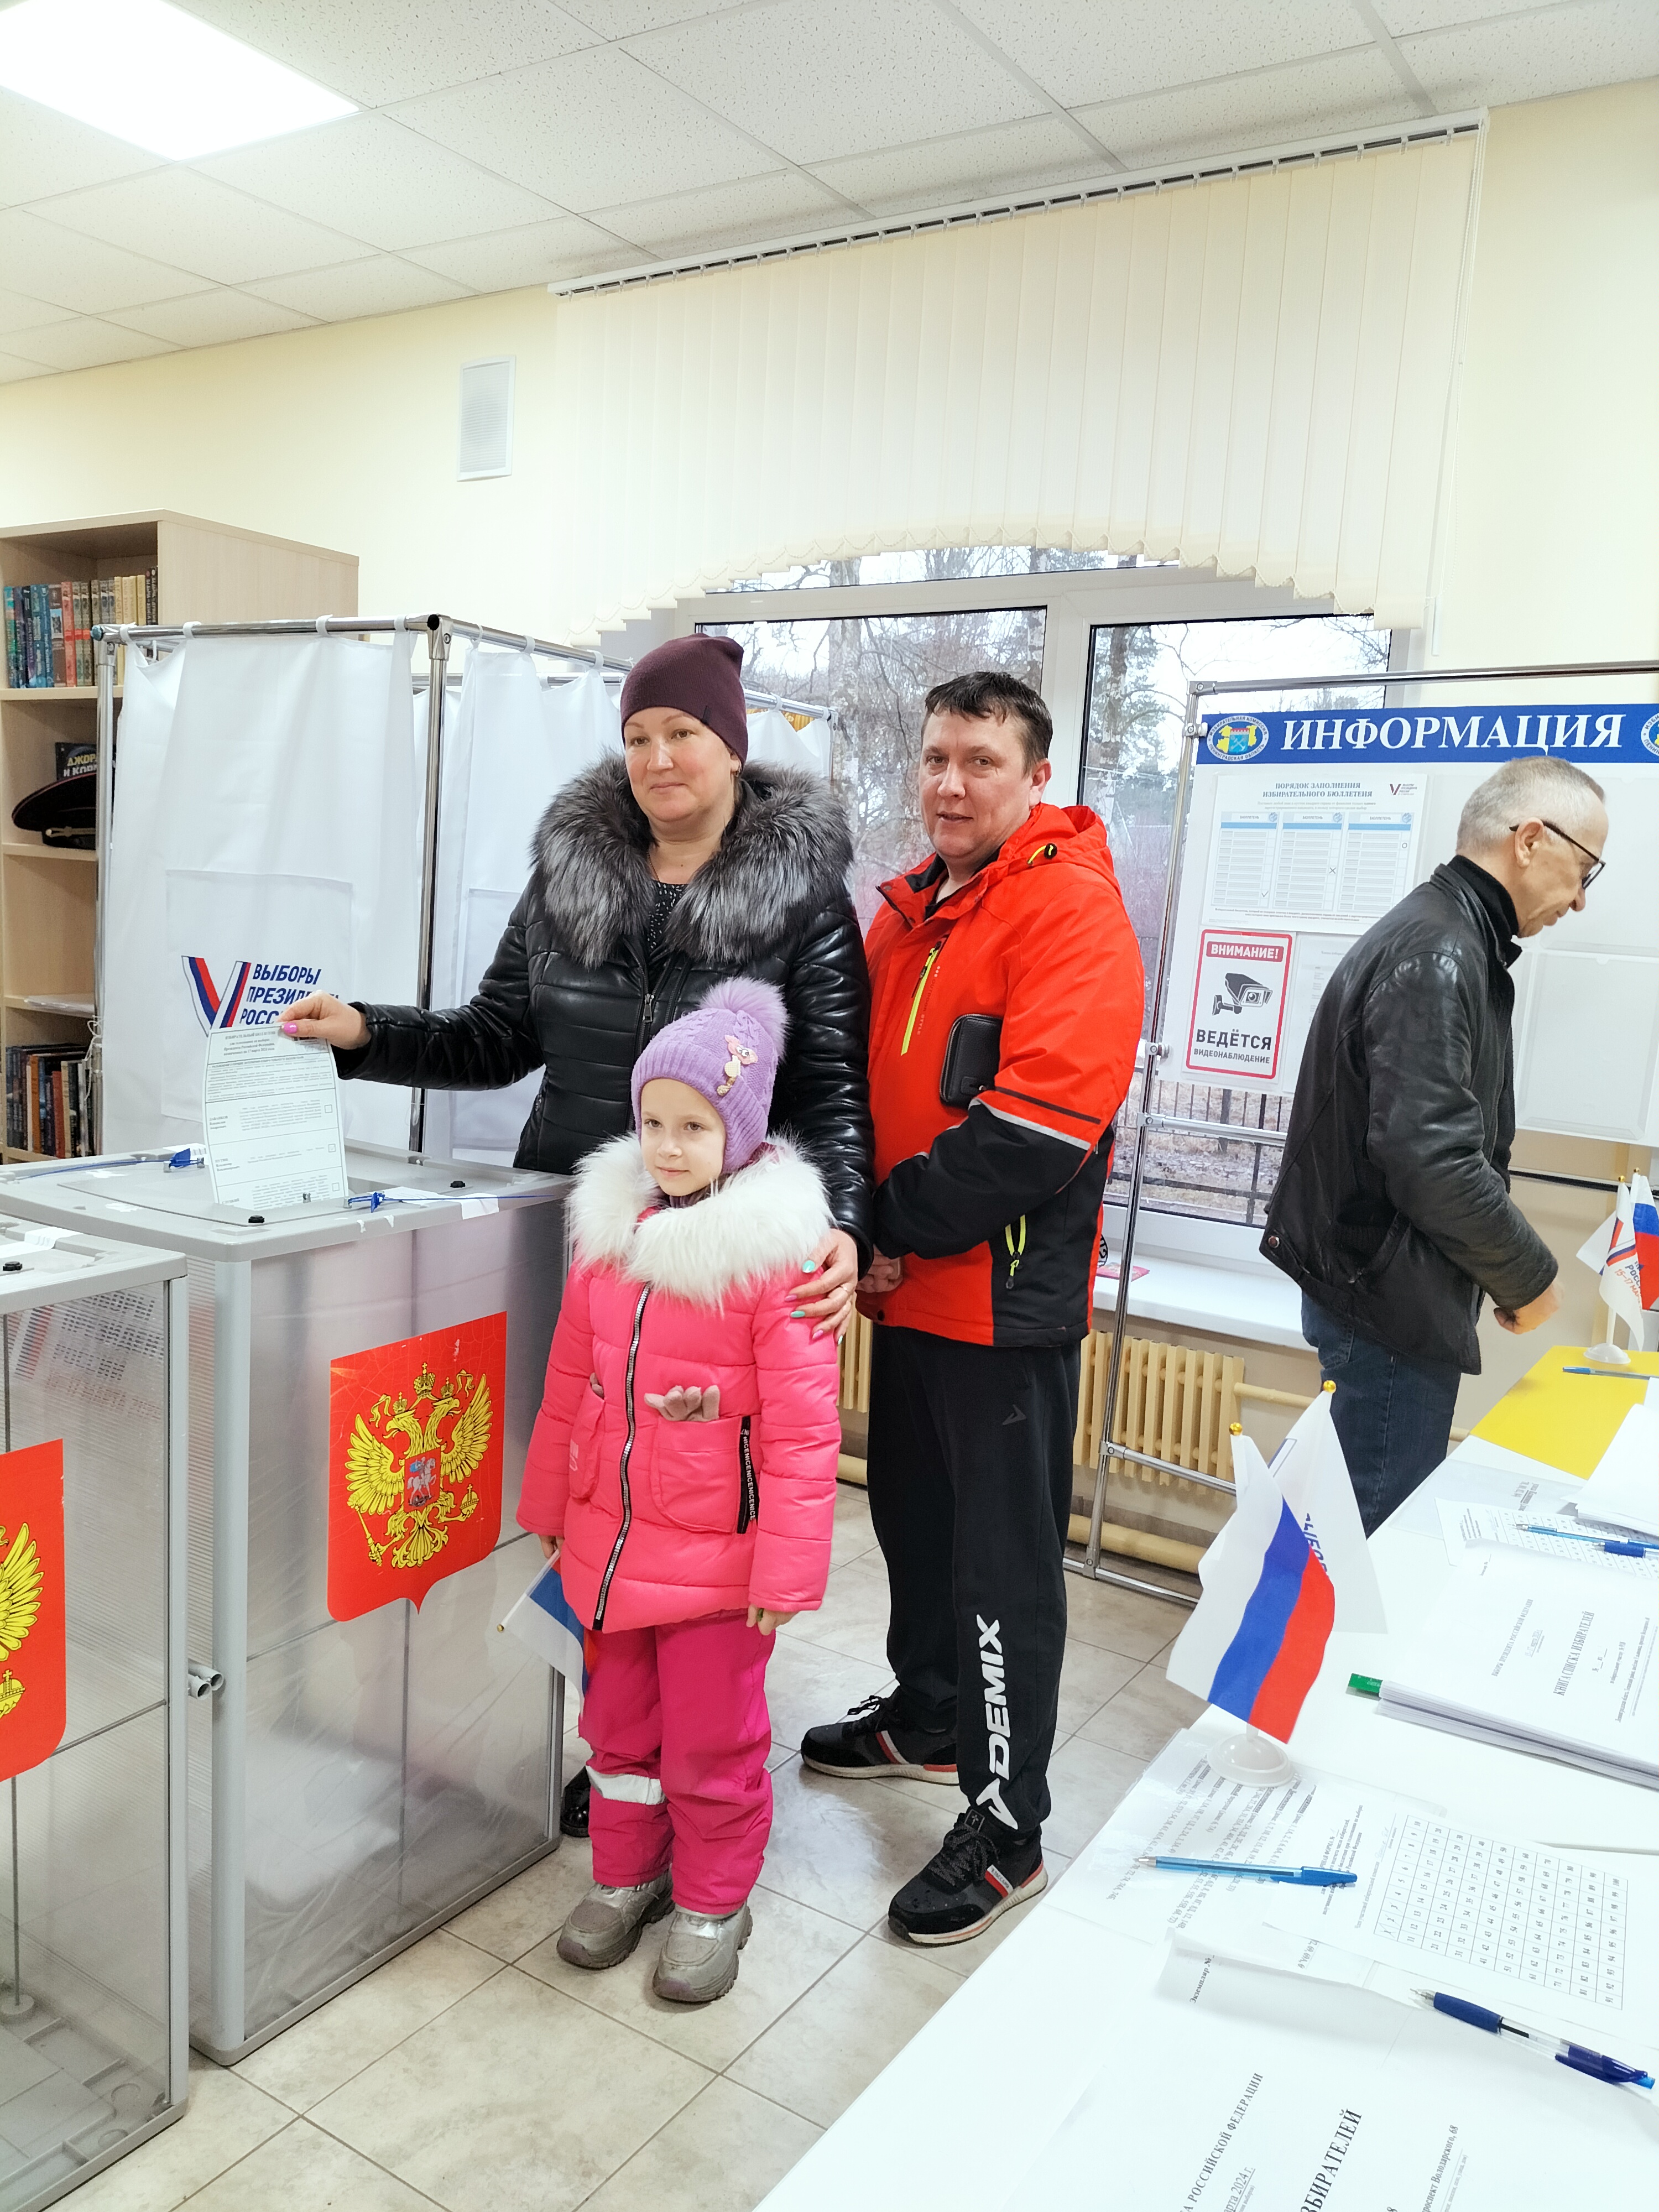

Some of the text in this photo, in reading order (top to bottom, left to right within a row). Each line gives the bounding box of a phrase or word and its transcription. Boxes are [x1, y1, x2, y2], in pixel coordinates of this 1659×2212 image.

[1280, 714, 1626, 756] ИНФОРМАЦИЯ
[1211, 944, 1279, 959] ВНИМАНИЕ!
[253, 964, 322, 985] ВЫБОРЫ
[239, 1008, 284, 1025] РОСС
[1194, 1048, 1270, 1064] ВИДЕОНАБЛЮДЕНИЕ
[1196, 1029, 1272, 1051] ВЕДЁТСЯ
[1553, 1611, 1595, 1696] КНИГА СПИСКА ИЗБИРАТЕЛЕЙ
[976, 1614, 1011, 1781] DEMIX
[1190, 1968, 1209, 2004] Экземпляр
[1187, 2073, 1263, 2203] РОССИЙСКОЙ ФЕДЕРАЦИИ
[1300, 2108, 1362, 2212] ЗБИРАТЕЛЕЙ
[1422, 2125, 1458, 2212] роспект Володарского, 68
[1223, 2195, 1238, 2212] арта
[1236, 2171, 1250, 2194] 2024
[1244, 2166, 1254, 2174] г.
